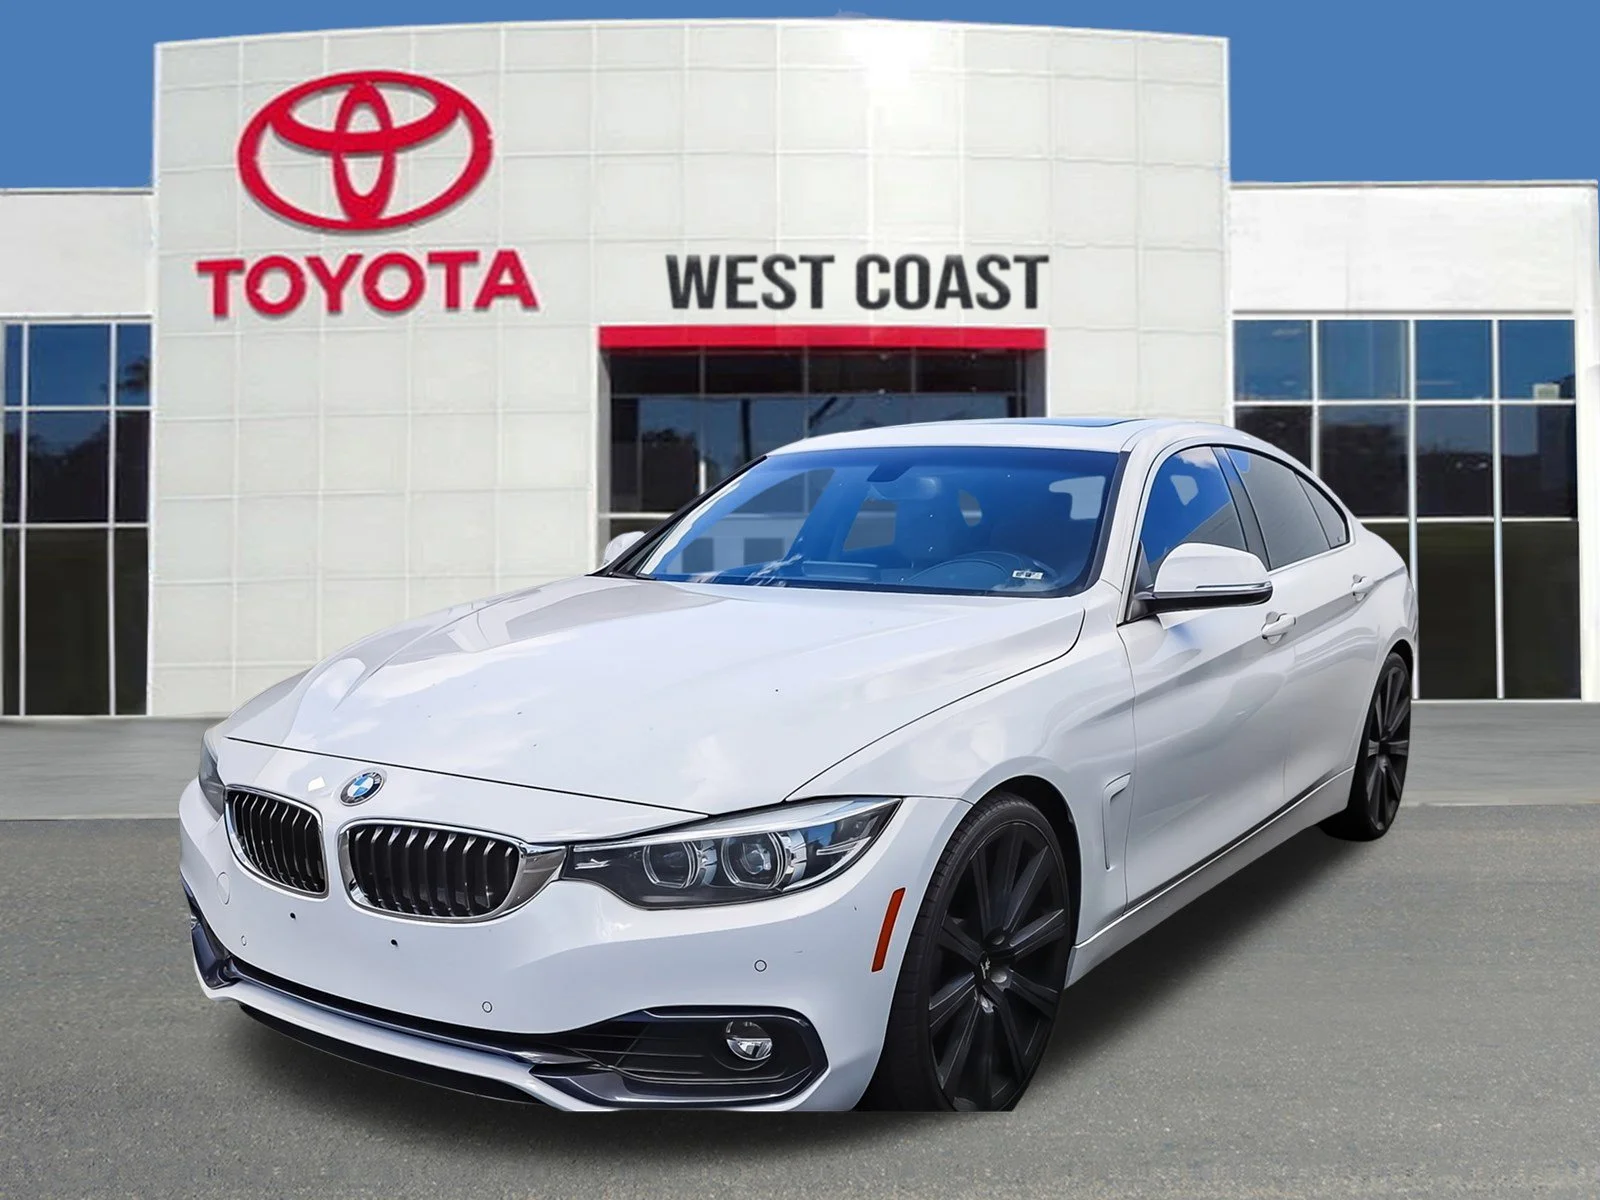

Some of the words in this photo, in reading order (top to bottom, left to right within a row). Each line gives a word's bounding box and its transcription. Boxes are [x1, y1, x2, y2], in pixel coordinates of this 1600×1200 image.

[196, 250, 539, 317] TOYOTA
[665, 253, 835, 310] WEST
[855, 253, 1050, 310] COAST
